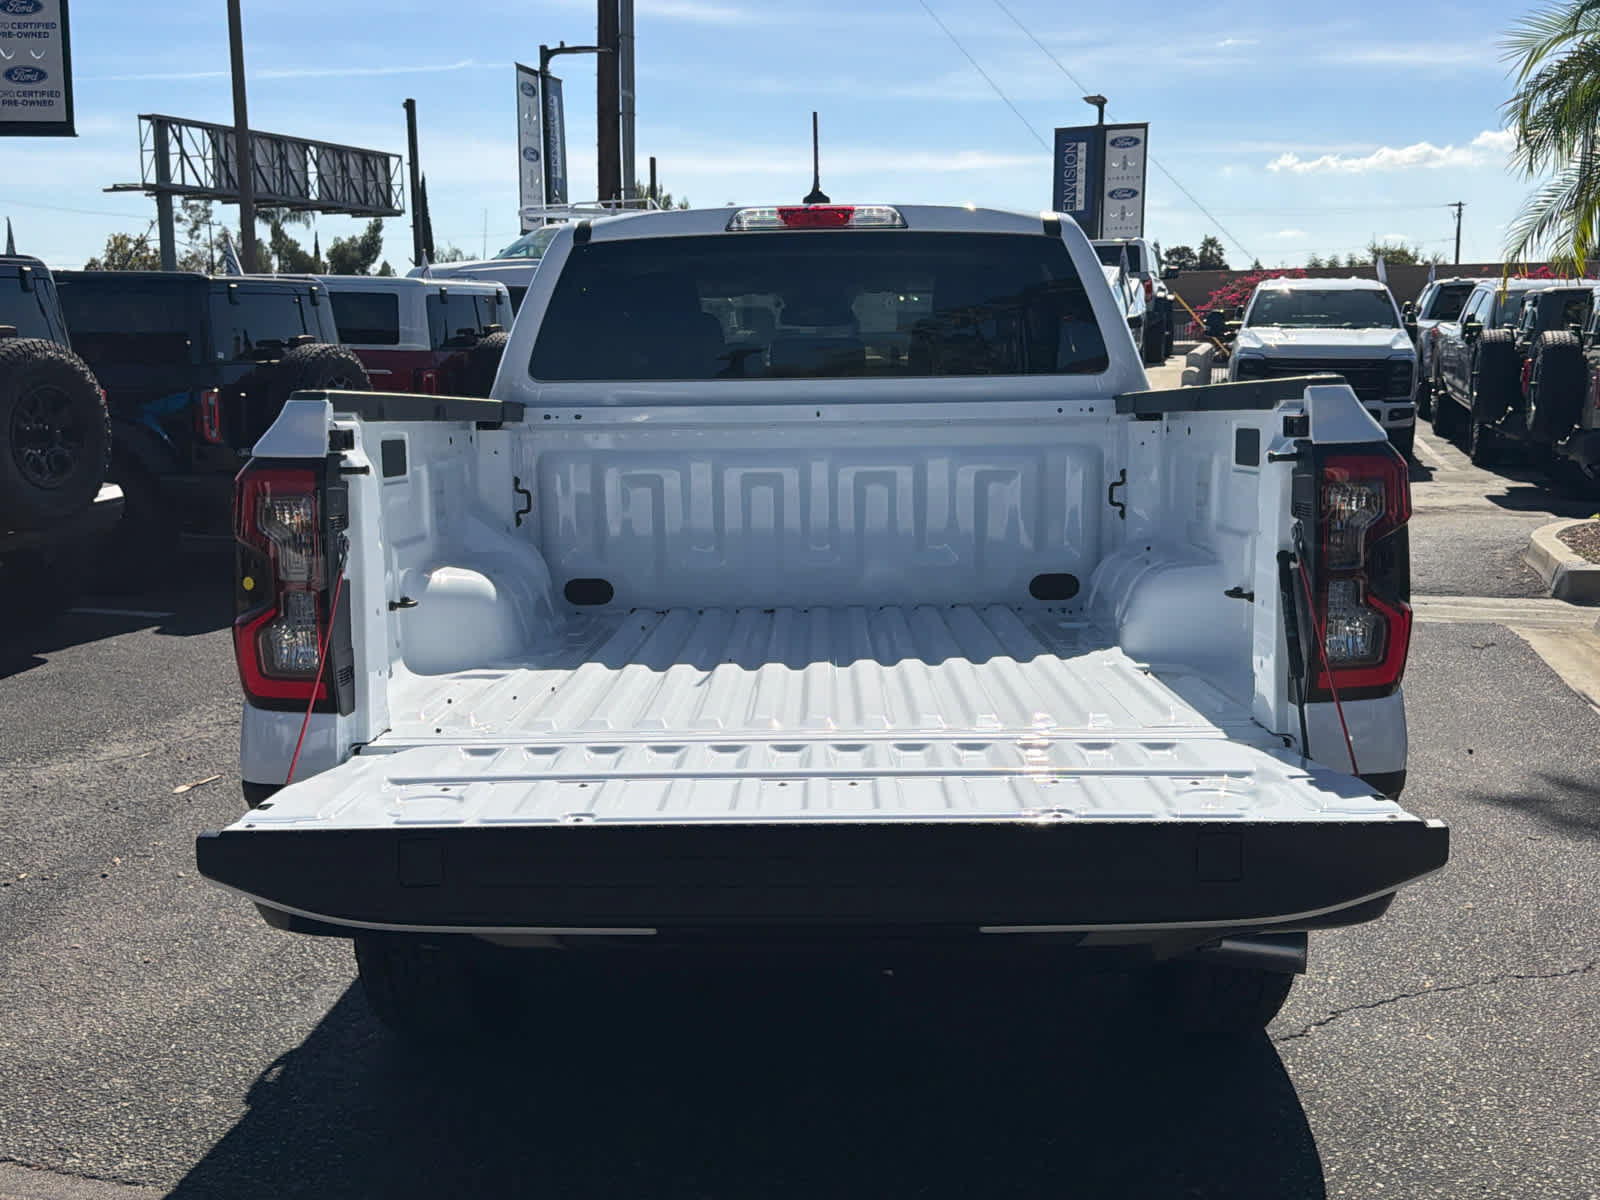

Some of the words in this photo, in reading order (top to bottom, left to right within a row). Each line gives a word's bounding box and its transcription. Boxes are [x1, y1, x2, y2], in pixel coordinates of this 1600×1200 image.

[10, 22, 57, 30] CERTIFIED
[16, 90, 61, 98] CERTIFIED
[2, 99, 54, 107] PRE-OWNED
[1063, 142, 1077, 212] ENVISION
